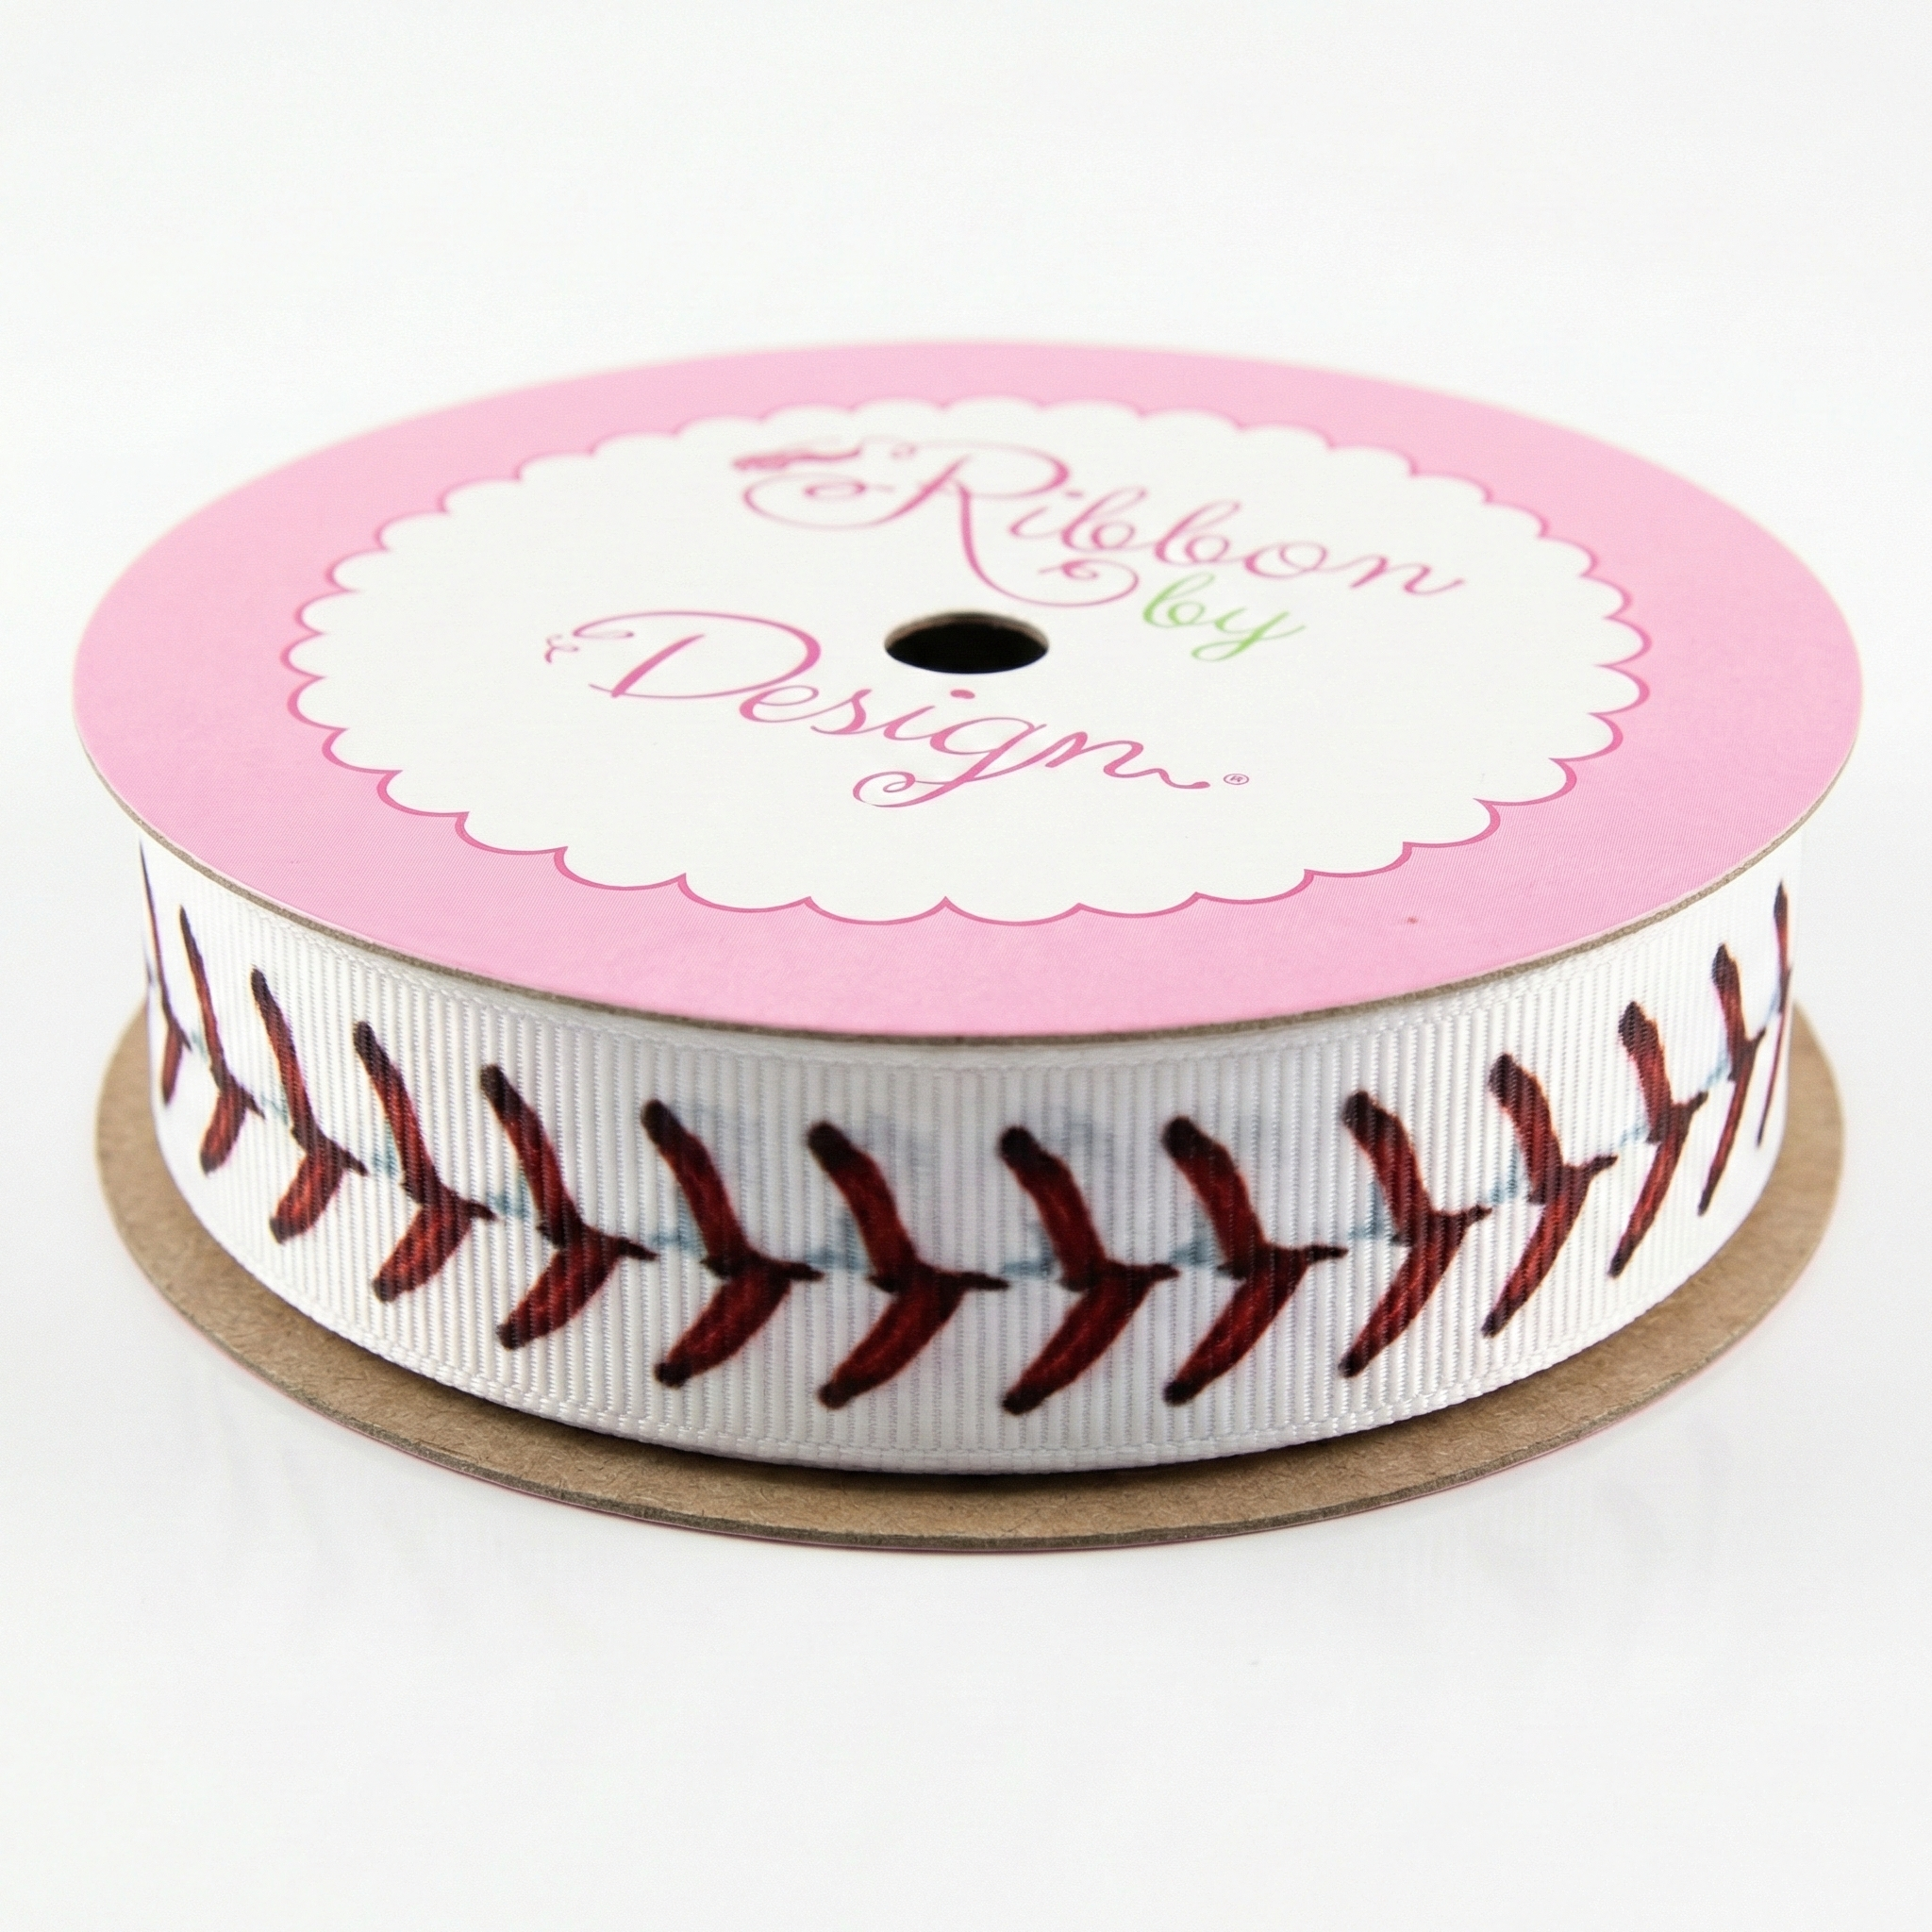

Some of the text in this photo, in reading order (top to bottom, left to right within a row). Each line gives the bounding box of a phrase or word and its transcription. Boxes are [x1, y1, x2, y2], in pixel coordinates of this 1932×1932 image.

[731, 439, 1466, 608] Ribbon
[1141, 572, 1306, 663] by
[544, 608, 1211, 809] Design
